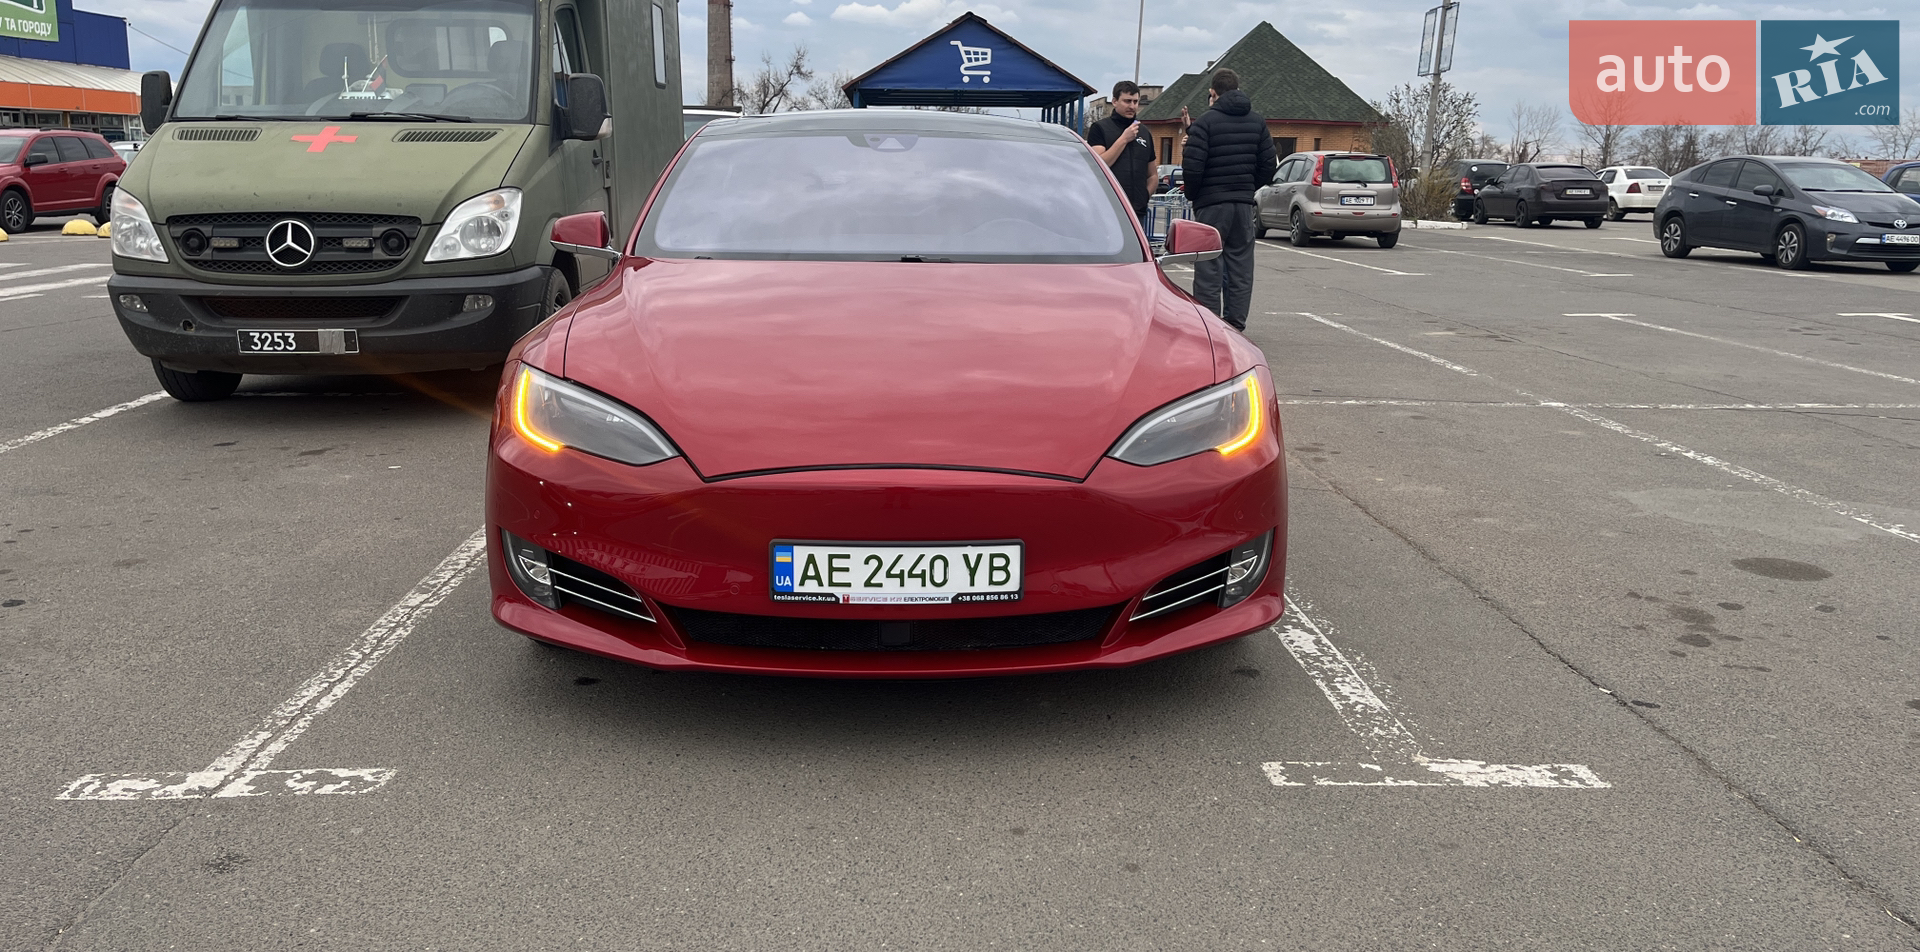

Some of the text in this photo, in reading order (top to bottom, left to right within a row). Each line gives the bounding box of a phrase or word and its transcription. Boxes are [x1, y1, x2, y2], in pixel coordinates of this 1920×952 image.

[4, 17, 17, 31] ТА
[18, 19, 52, 37] ГОРОДУ
[249, 332, 297, 351] 3253
[798, 553, 1011, 588] AE 2440 YB
[775, 575, 792, 587] UA
[773, 594, 836, 602] teslaservice.kr.ua
